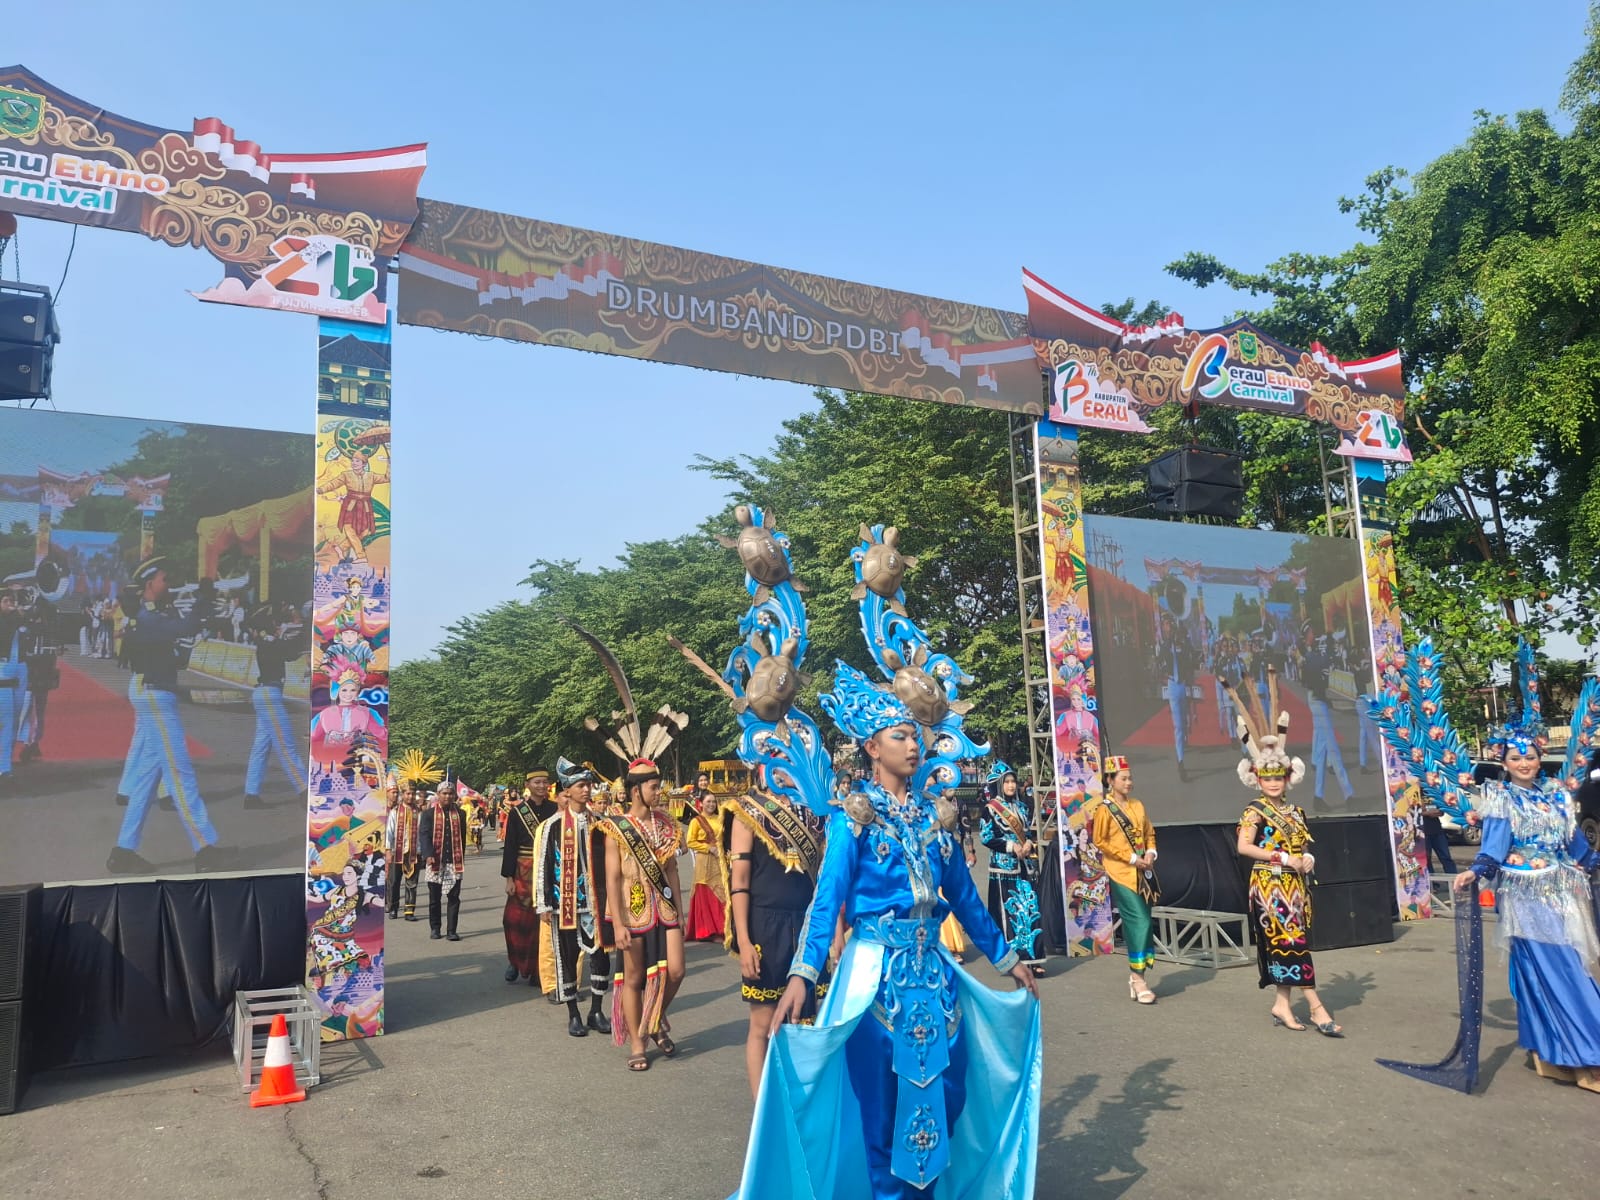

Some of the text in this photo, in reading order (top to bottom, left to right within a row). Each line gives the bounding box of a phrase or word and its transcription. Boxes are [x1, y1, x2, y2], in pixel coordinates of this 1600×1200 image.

[0, 151, 165, 192] au Ethno
[3, 178, 112, 210] rnival
[607, 280, 903, 356] DRUMBAND PDBI
[1231, 382, 1293, 404] Carnival
[1266, 371, 1311, 390] Ethno
[1094, 392, 1126, 403] KABUPATEN
[623, 830, 635, 847] DUTA
[774, 809, 793, 831] PUTRA
[788, 825, 806, 845] DUTA
[565, 847, 574, 875] DUTA
[564, 876, 574, 919] BUDAYA
